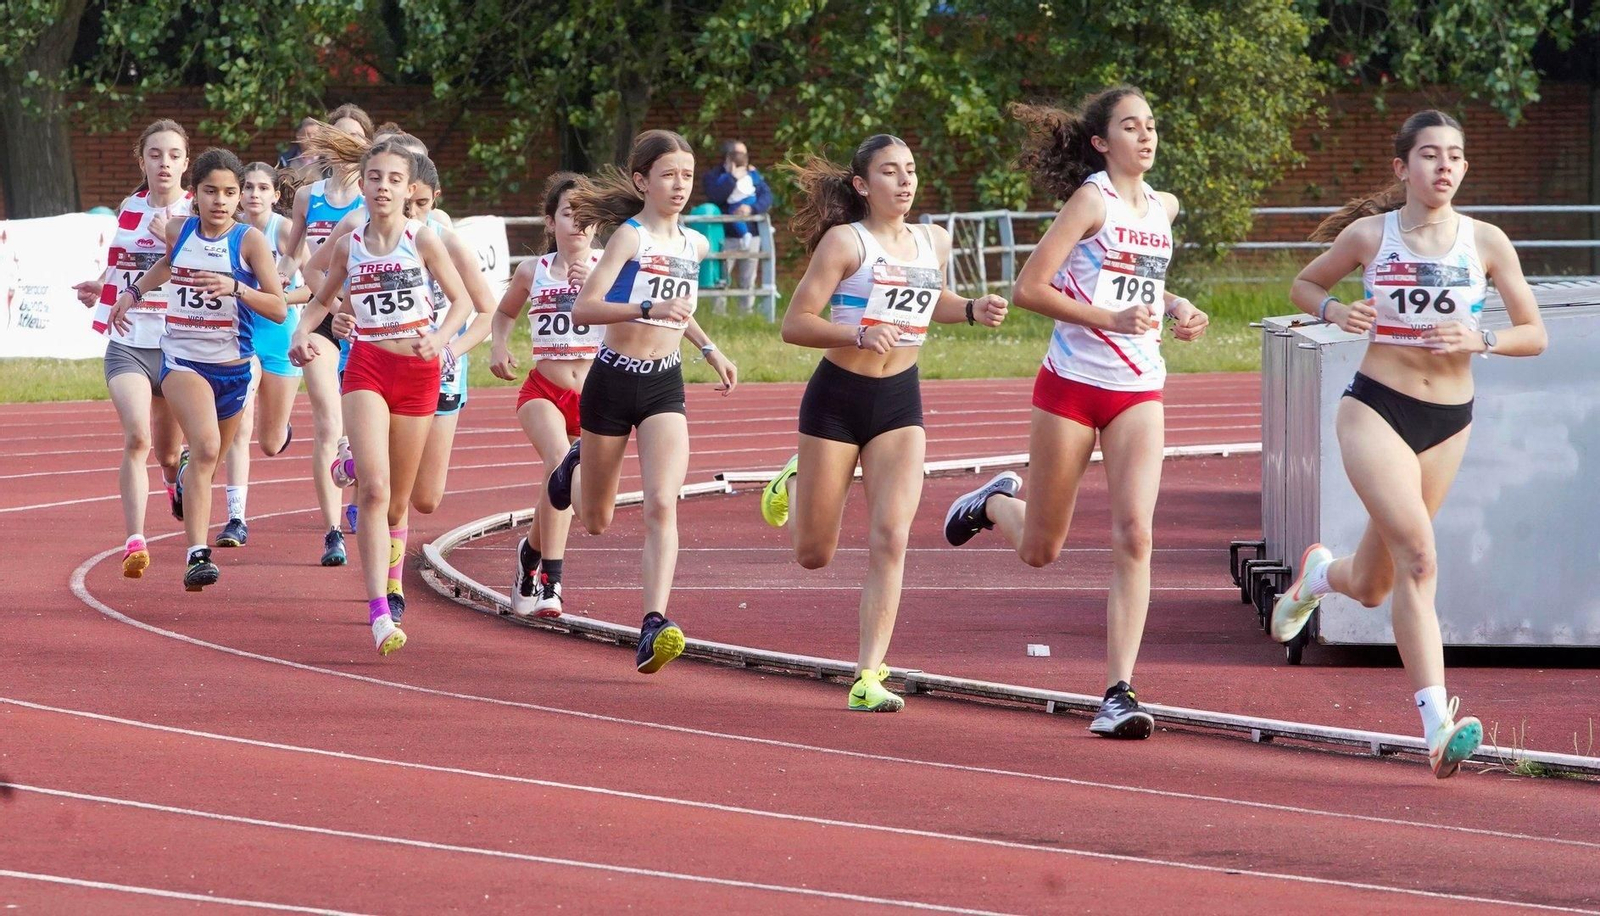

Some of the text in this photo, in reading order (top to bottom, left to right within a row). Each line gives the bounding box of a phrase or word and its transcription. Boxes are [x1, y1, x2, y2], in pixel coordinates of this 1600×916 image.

[1115, 227, 1170, 249] TREGA
[359, 263, 403, 274] TREGA
[176, 286, 223, 311] 133
[647, 276, 691, 301] 180
[1111, 275, 1156, 305] 198
[362, 290, 415, 316] 135
[884, 288, 932, 314] 129
[1389, 288, 1456, 314] 196
[187, 315, 204, 323] VIGO
[382, 321, 400, 330] VIGO
[893, 319, 910, 329] VIGO
[1411, 323, 1433, 332] VIGO
[613, 355, 654, 374] PRO
